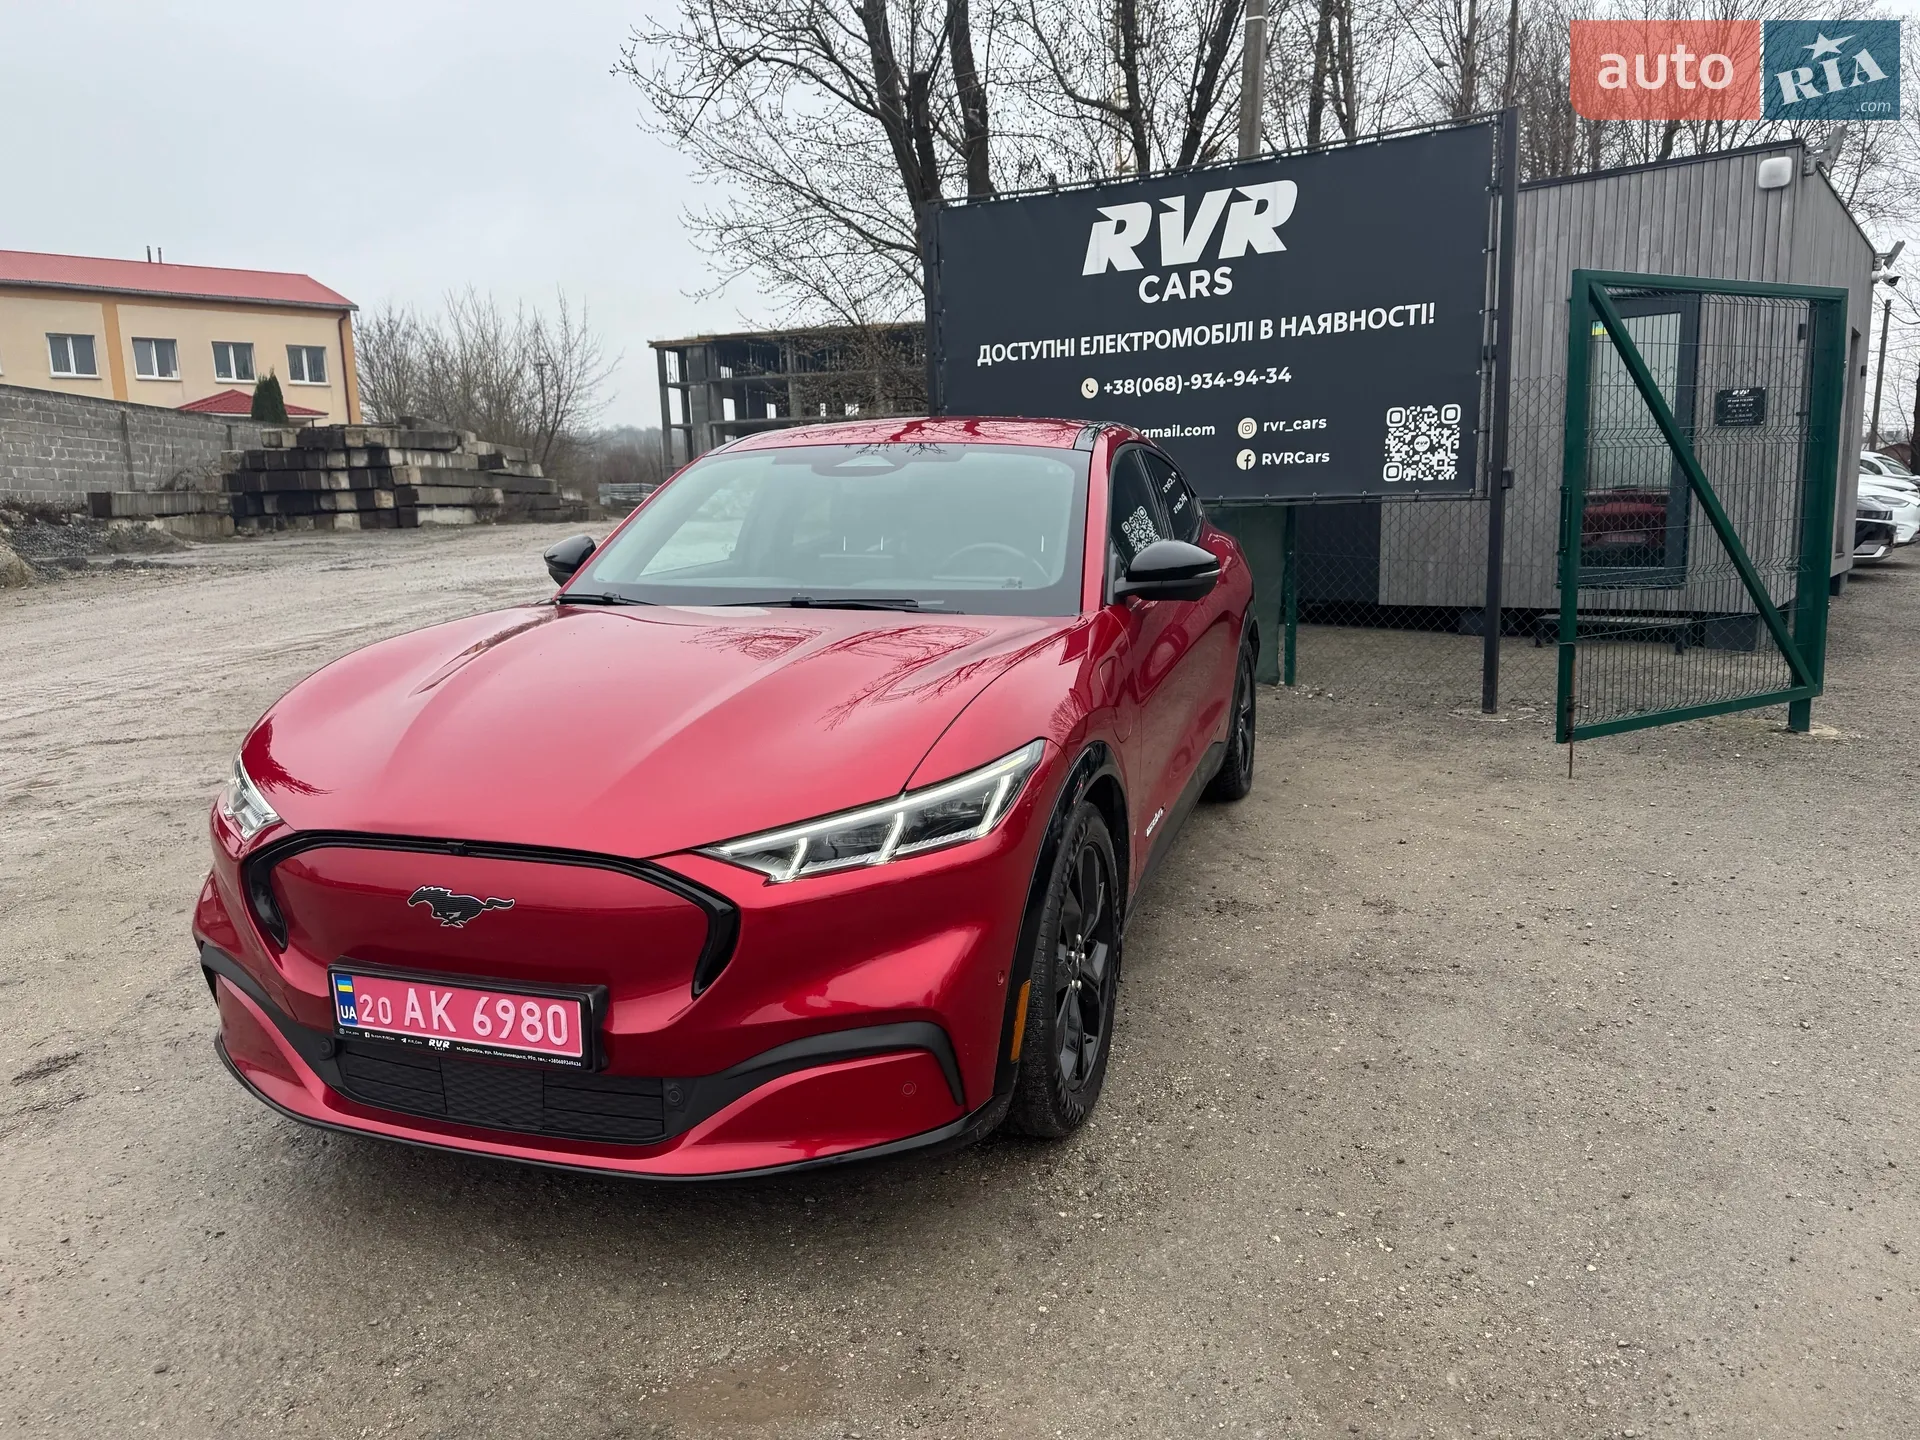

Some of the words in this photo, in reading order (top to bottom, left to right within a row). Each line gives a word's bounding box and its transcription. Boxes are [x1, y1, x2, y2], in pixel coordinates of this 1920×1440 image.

[1081, 178, 1297, 277] RVR
[1138, 266, 1232, 303] CARS
[977, 338, 1074, 366] ДОСТУПНІ
[1081, 321, 1253, 355] ЕЛЕКТРОМОБІЛІ
[1260, 319, 1273, 339] В
[1281, 302, 1434, 337] НАЯВНОСТІ!
[1104, 367, 1291, 397] +38(068)-934-94-34
[1133, 424, 1216, 438] gmail.com
[1264, 419, 1326, 432] rvr_cars
[1262, 452, 1329, 465] RVRCars
[340, 1005, 357, 1020] UA
[359, 994, 393, 1025] 20
[404, 988, 457, 1032] AK
[473, 996, 568, 1046] 6980
[428, 1039, 450, 1049] RVR
